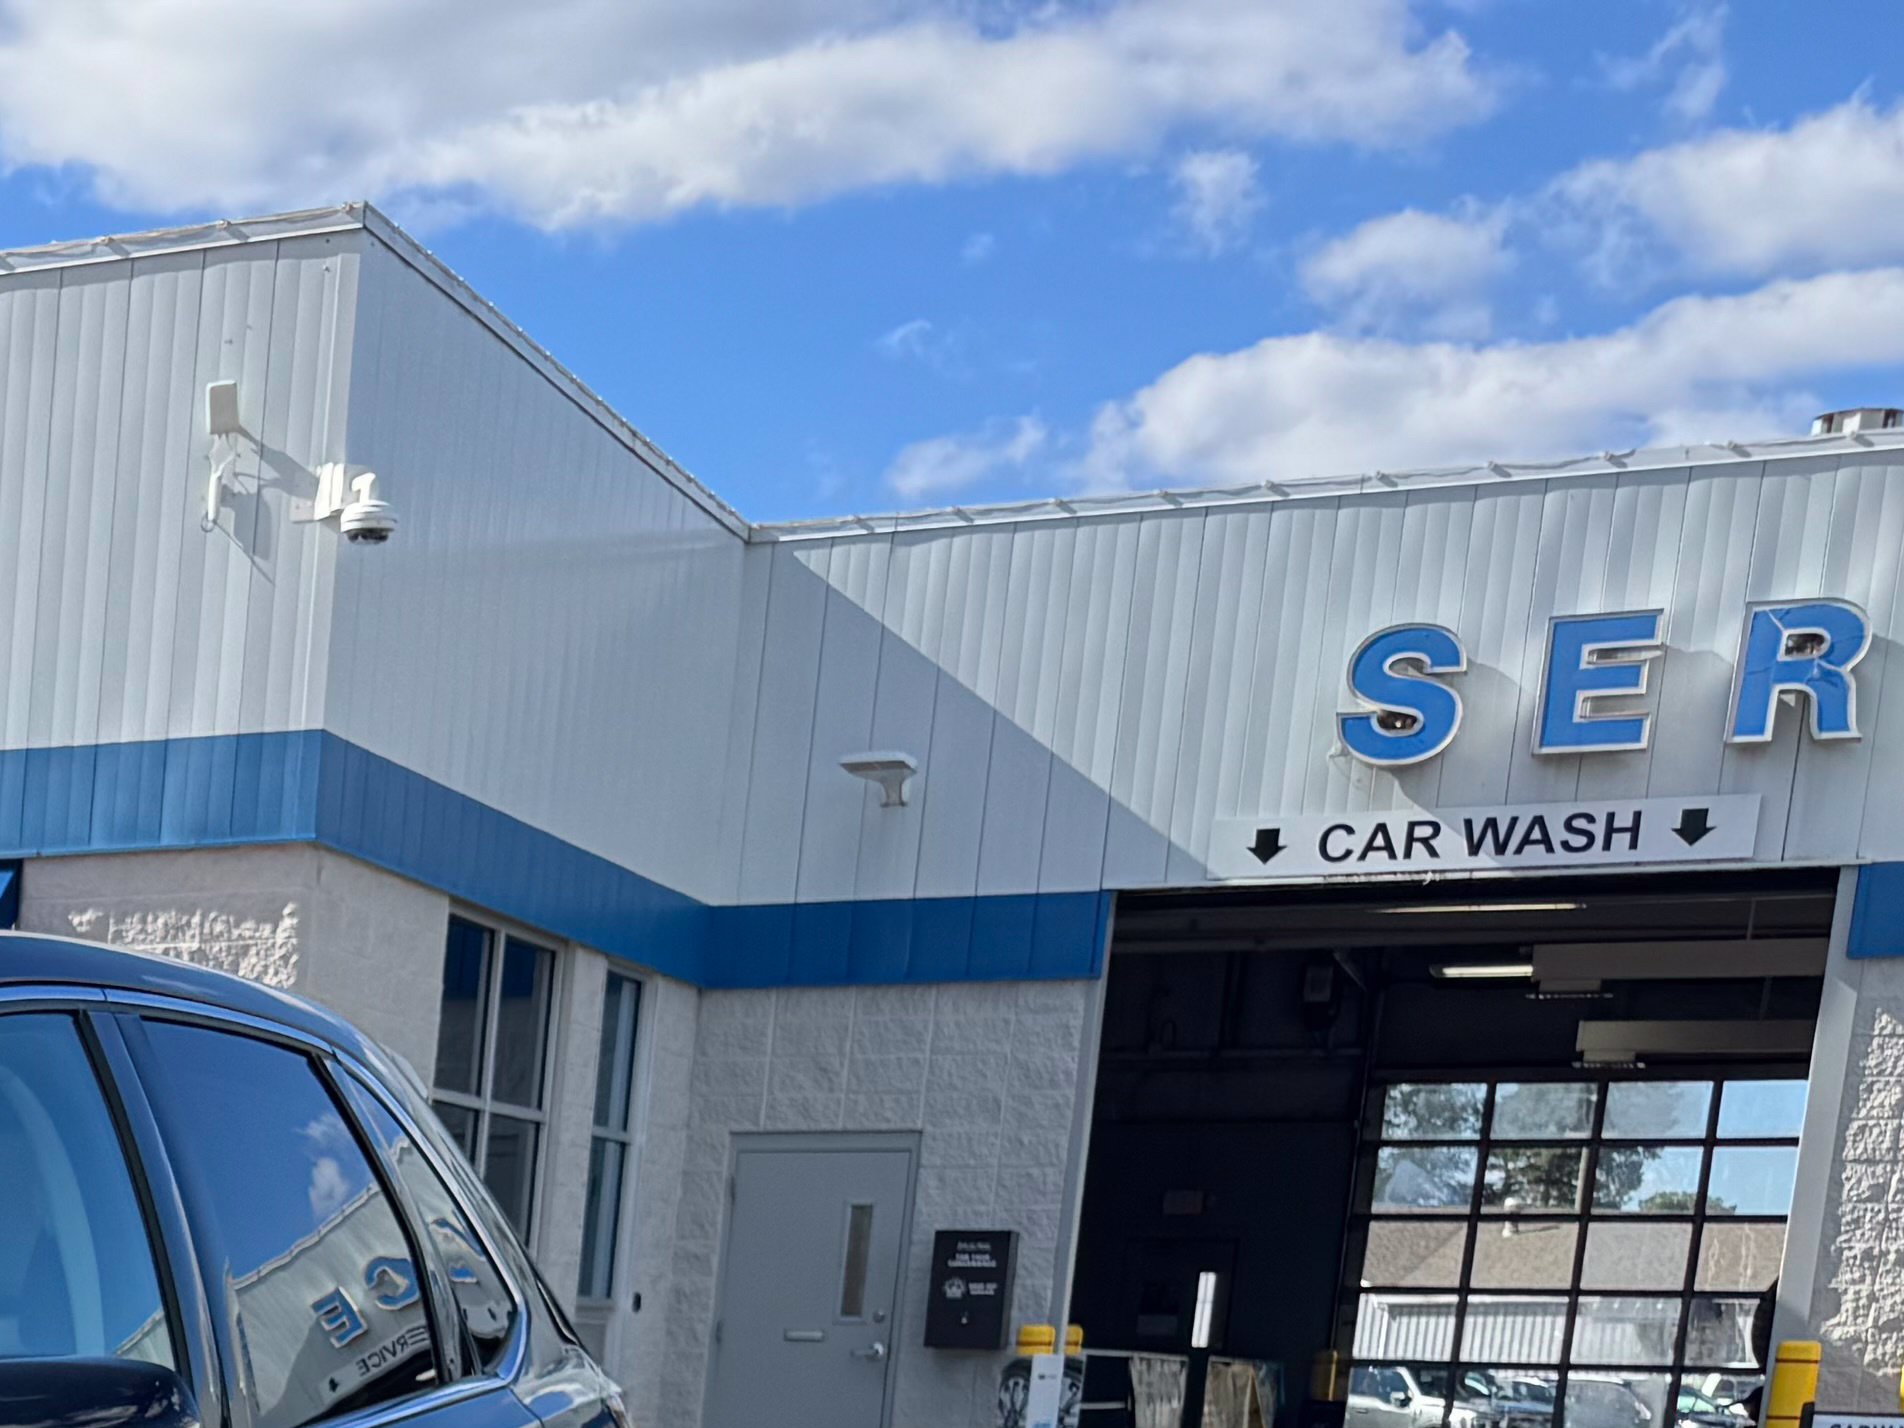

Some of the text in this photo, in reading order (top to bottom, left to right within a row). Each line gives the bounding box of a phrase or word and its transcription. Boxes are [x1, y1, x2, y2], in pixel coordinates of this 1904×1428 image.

[1335, 597, 1870, 767] SER
[1317, 809, 1643, 863] CAR WASH
